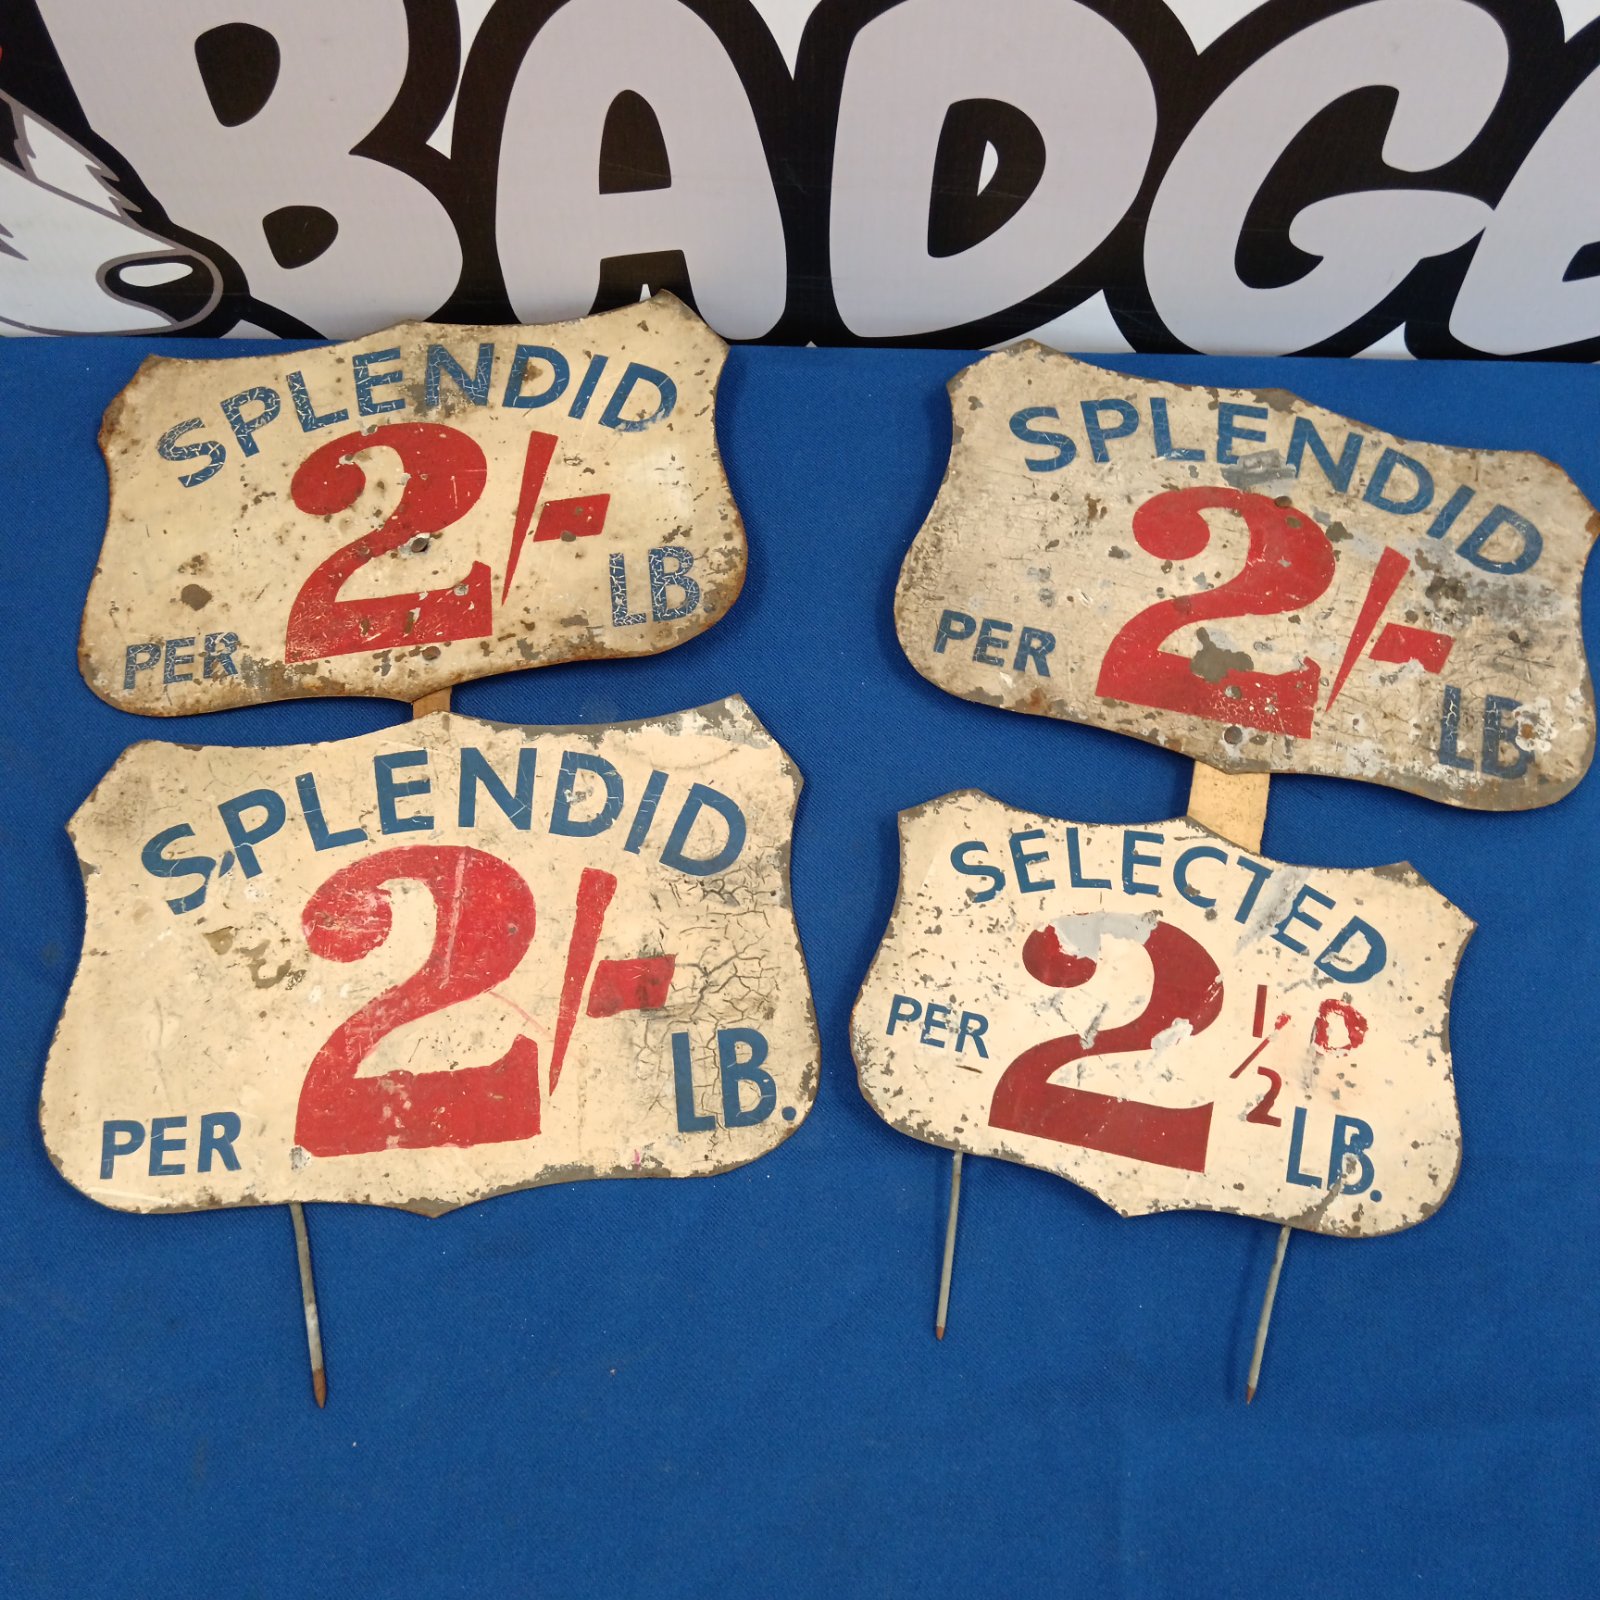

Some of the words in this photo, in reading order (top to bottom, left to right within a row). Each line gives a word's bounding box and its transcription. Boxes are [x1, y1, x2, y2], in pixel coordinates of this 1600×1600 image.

[157, 343, 678, 488] SPLENDID
[285, 421, 611, 664] 2/-
[1009, 397, 1544, 575] SPLENDID
[608, 545, 701, 627] LB
[932, 609, 1057, 678] PER
[1095, 485, 1455, 740] 2/-
[123, 631, 240, 691] PER
[141, 747, 747, 915] SPLENDID
[951, 827, 1387, 984] SELECTED
[294, 844, 677, 1158] 2/-
[886, 994, 990, 1059] PER
[671, 1029, 798, 1134] LB.
[99, 1111, 242, 1180] PER
[1285, 1106, 1384, 1203] LB.
